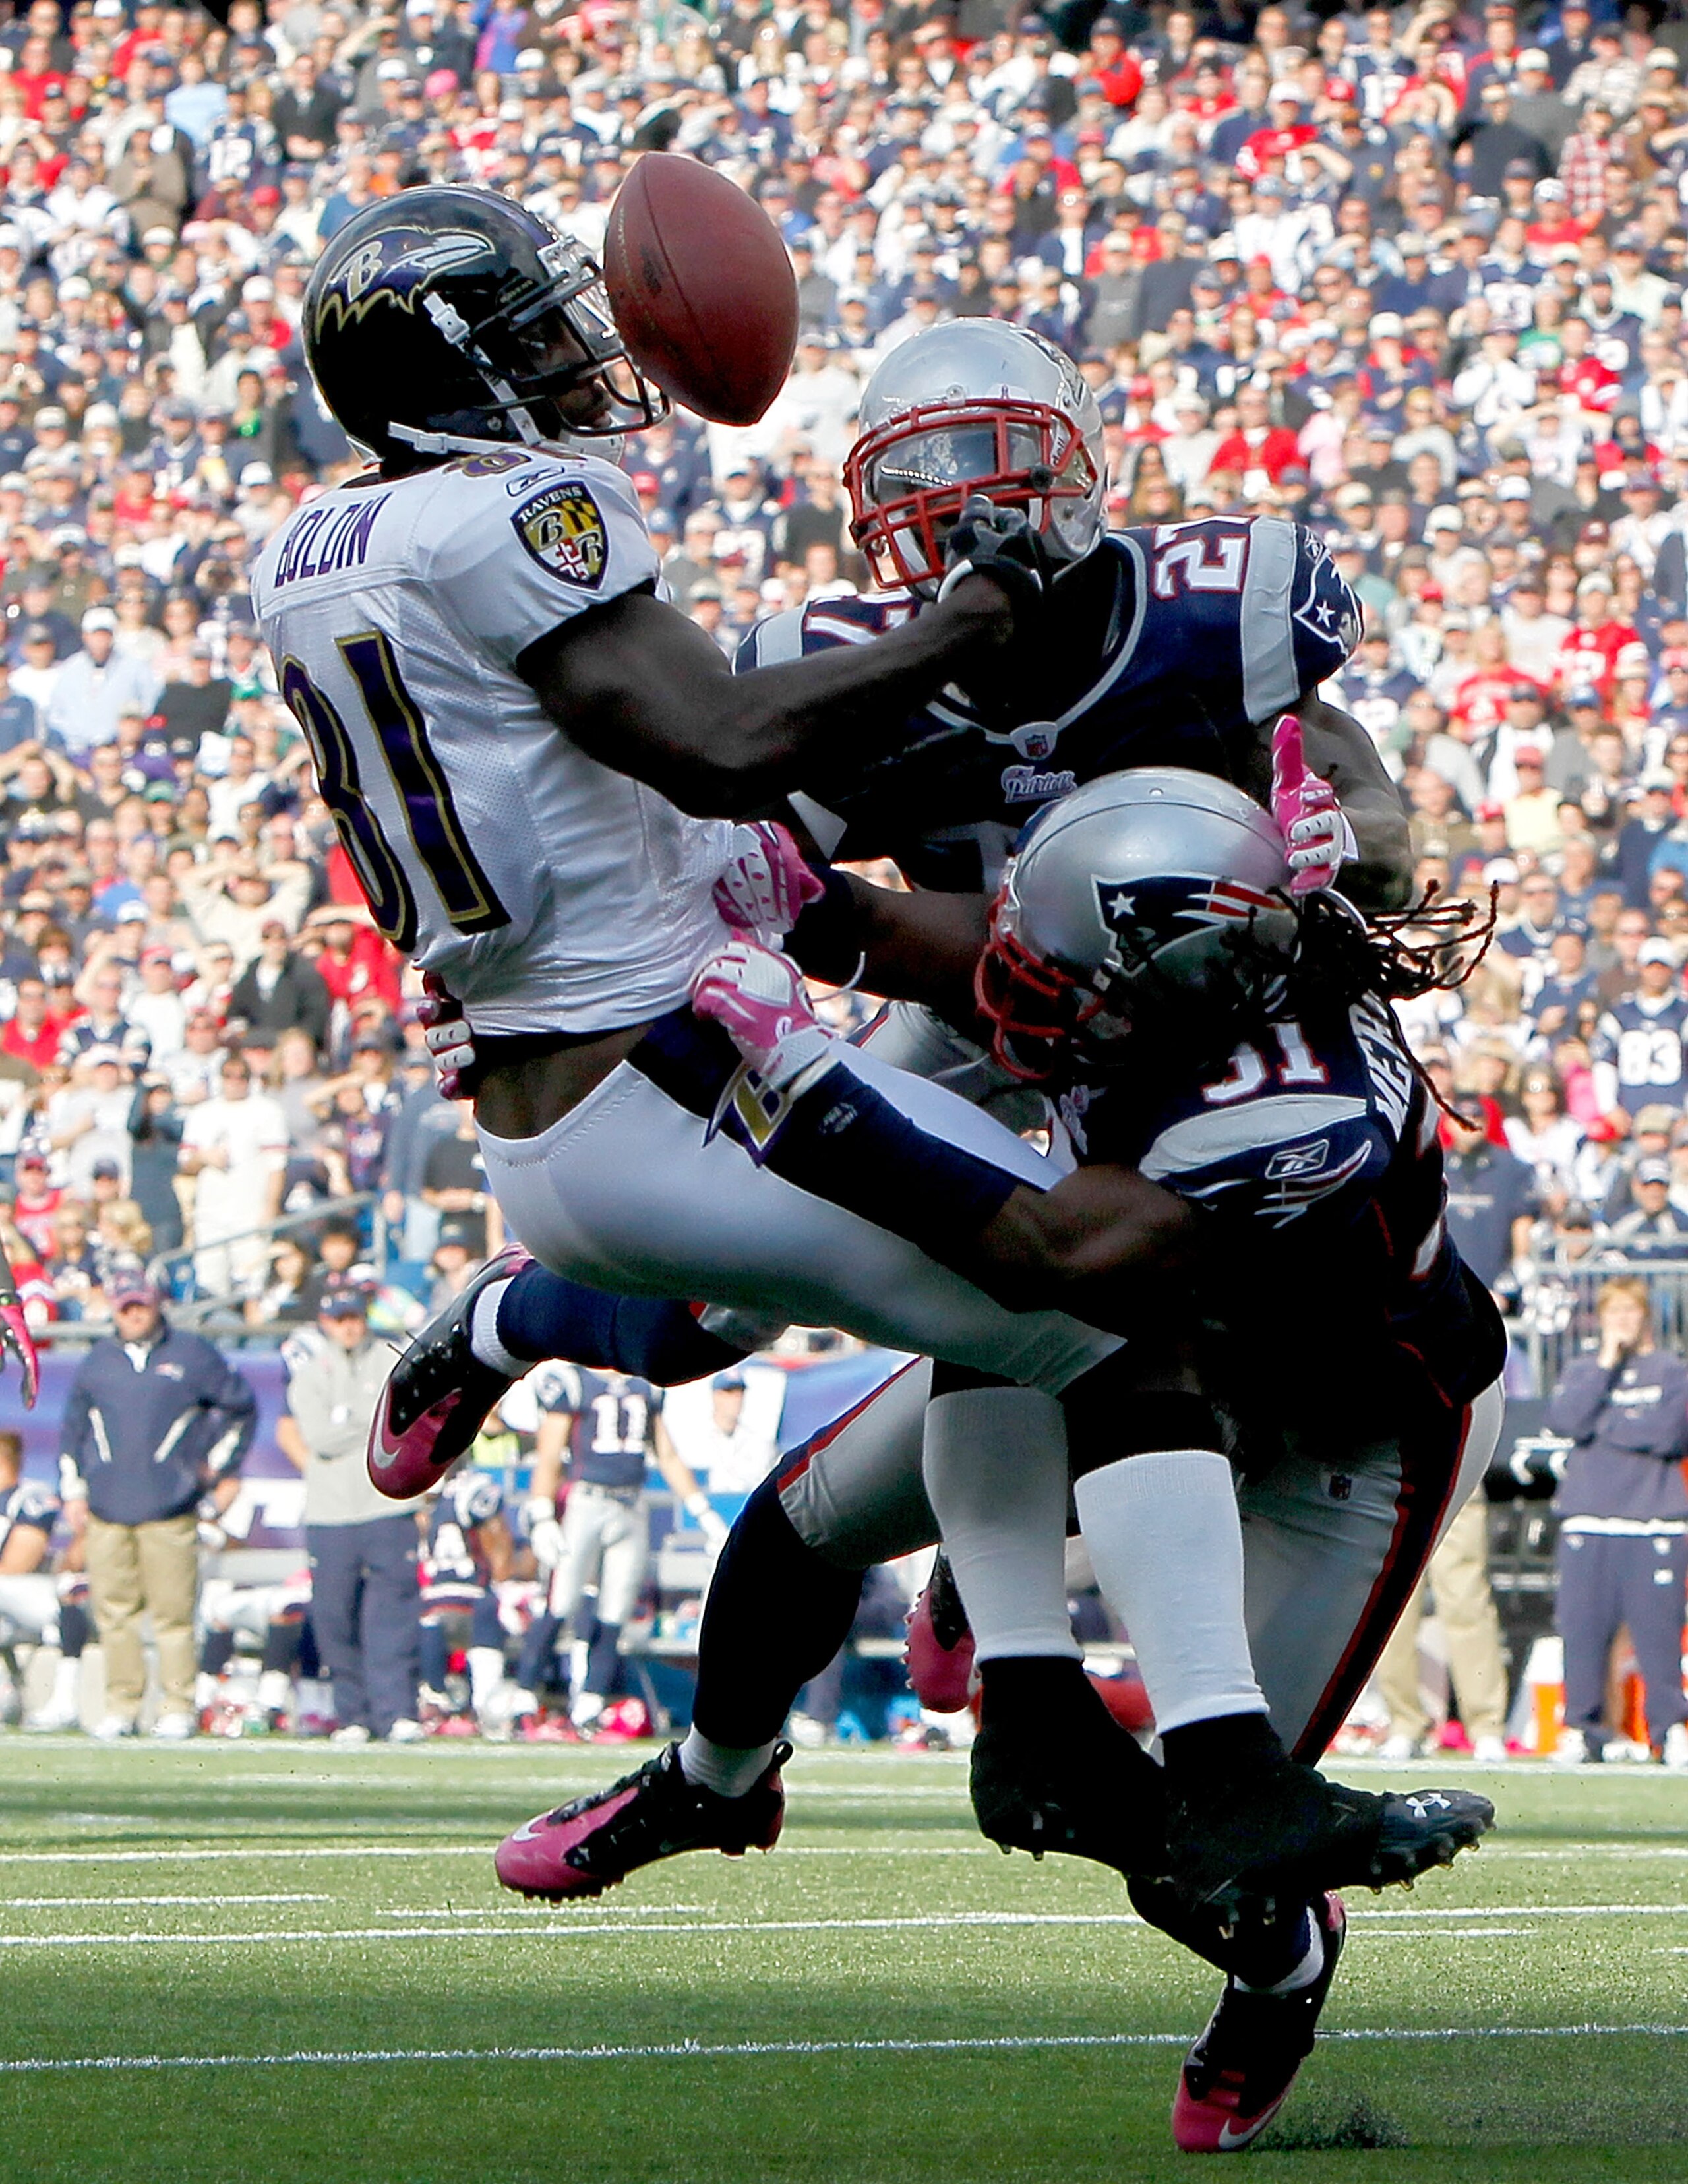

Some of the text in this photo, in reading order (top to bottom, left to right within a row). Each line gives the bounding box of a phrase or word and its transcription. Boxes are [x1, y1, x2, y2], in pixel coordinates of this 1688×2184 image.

[518, 485, 583, 523] RAVENS
[280, 629, 512, 953] 81
[591, 1394, 648, 1455] 11
